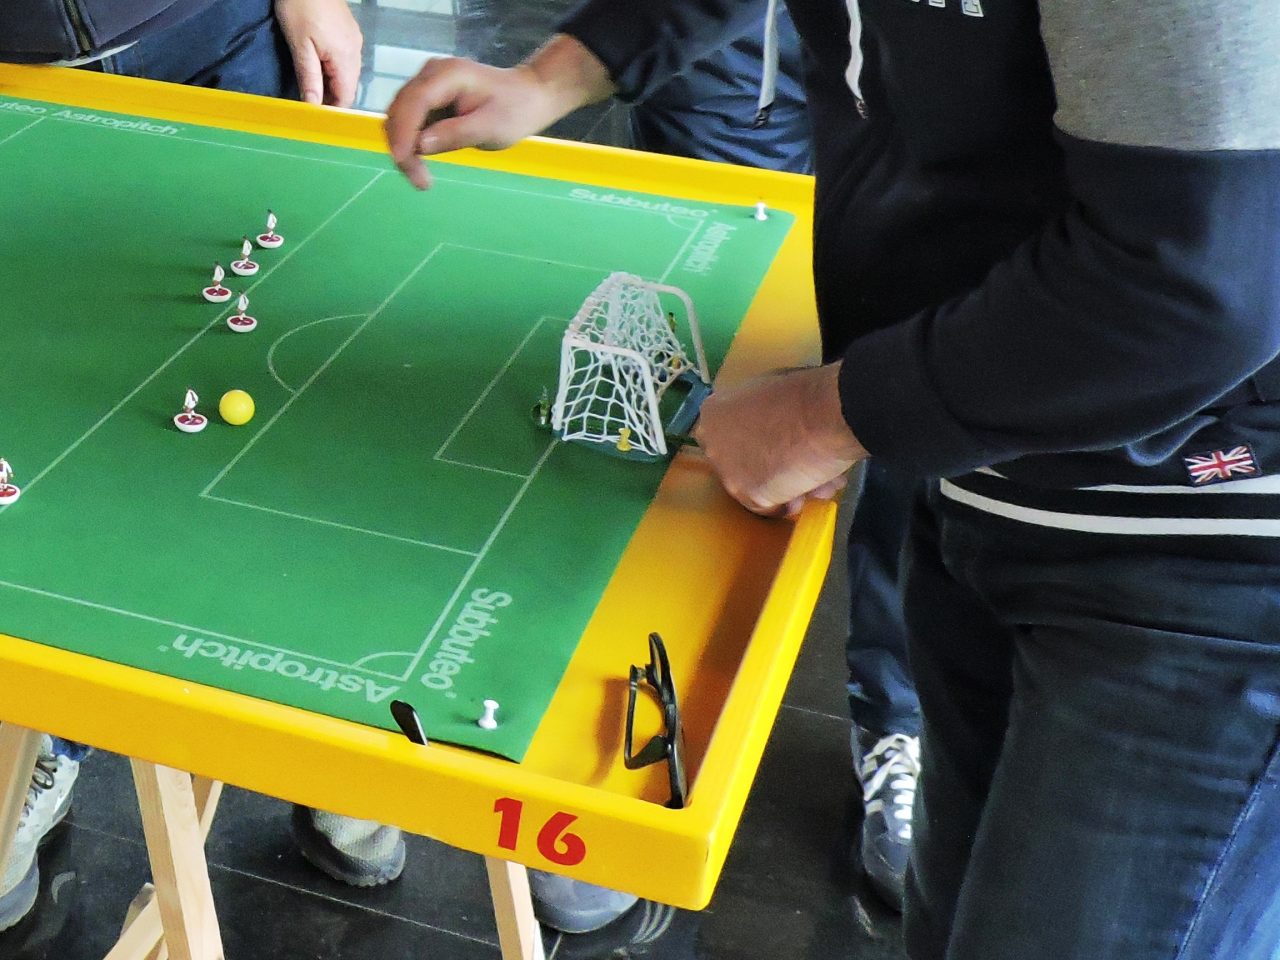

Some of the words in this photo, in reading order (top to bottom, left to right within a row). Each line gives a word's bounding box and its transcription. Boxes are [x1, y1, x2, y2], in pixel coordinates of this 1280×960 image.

[51, 109, 180, 136] Astropitch
[568, 188, 709, 218] Subbuteo
[171, 634, 402, 703] Astropitch
[420, 587, 513, 690] Subbuteo
[493, 797, 588, 866] 16
